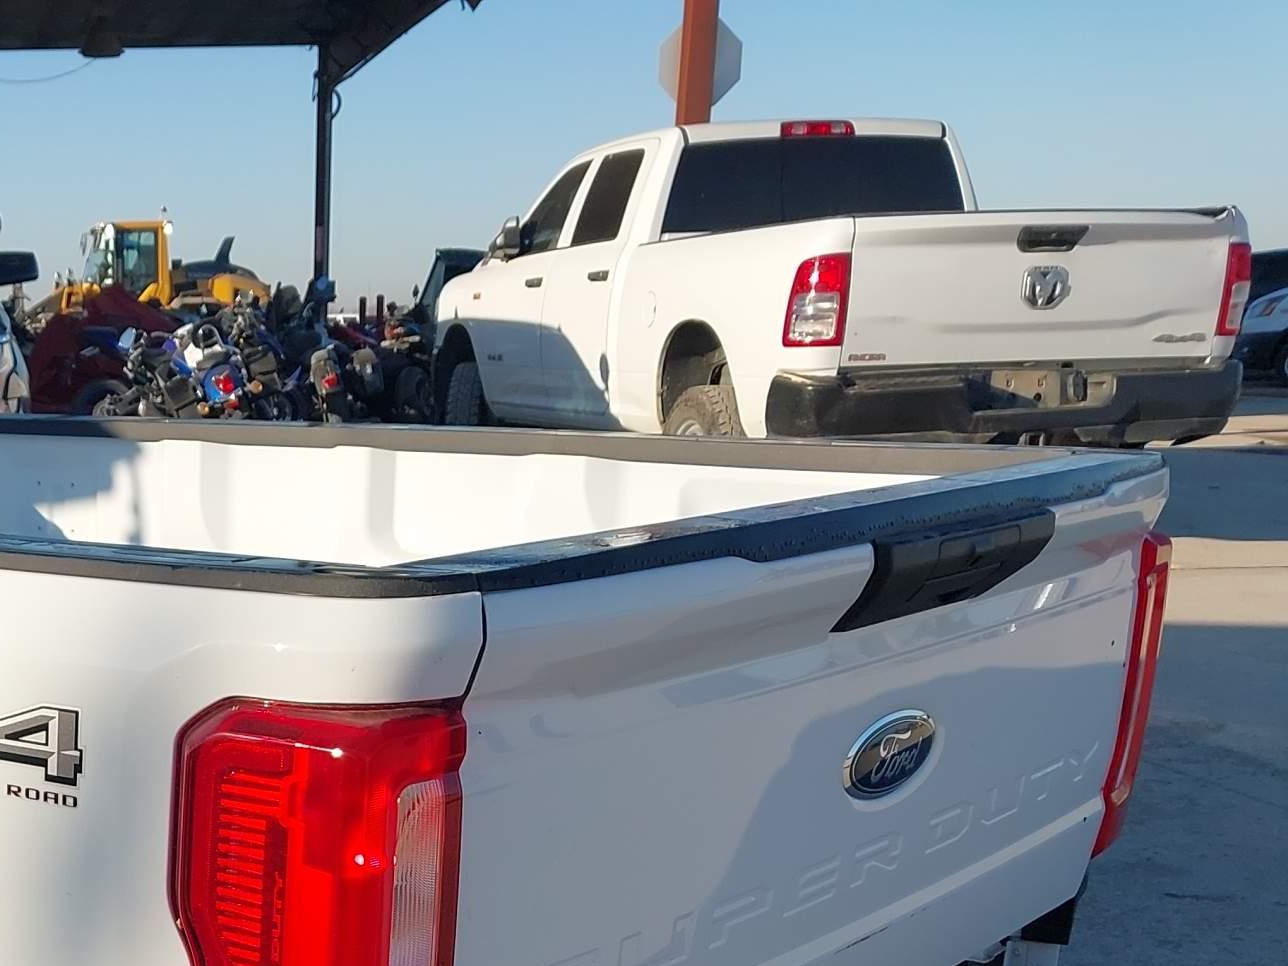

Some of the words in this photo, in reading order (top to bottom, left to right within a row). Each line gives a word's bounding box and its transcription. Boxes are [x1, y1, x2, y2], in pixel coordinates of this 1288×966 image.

[870, 729, 923, 783] Ford
[6, 783, 78, 808] ROAD
[924, 741, 1100, 855] DUTY
